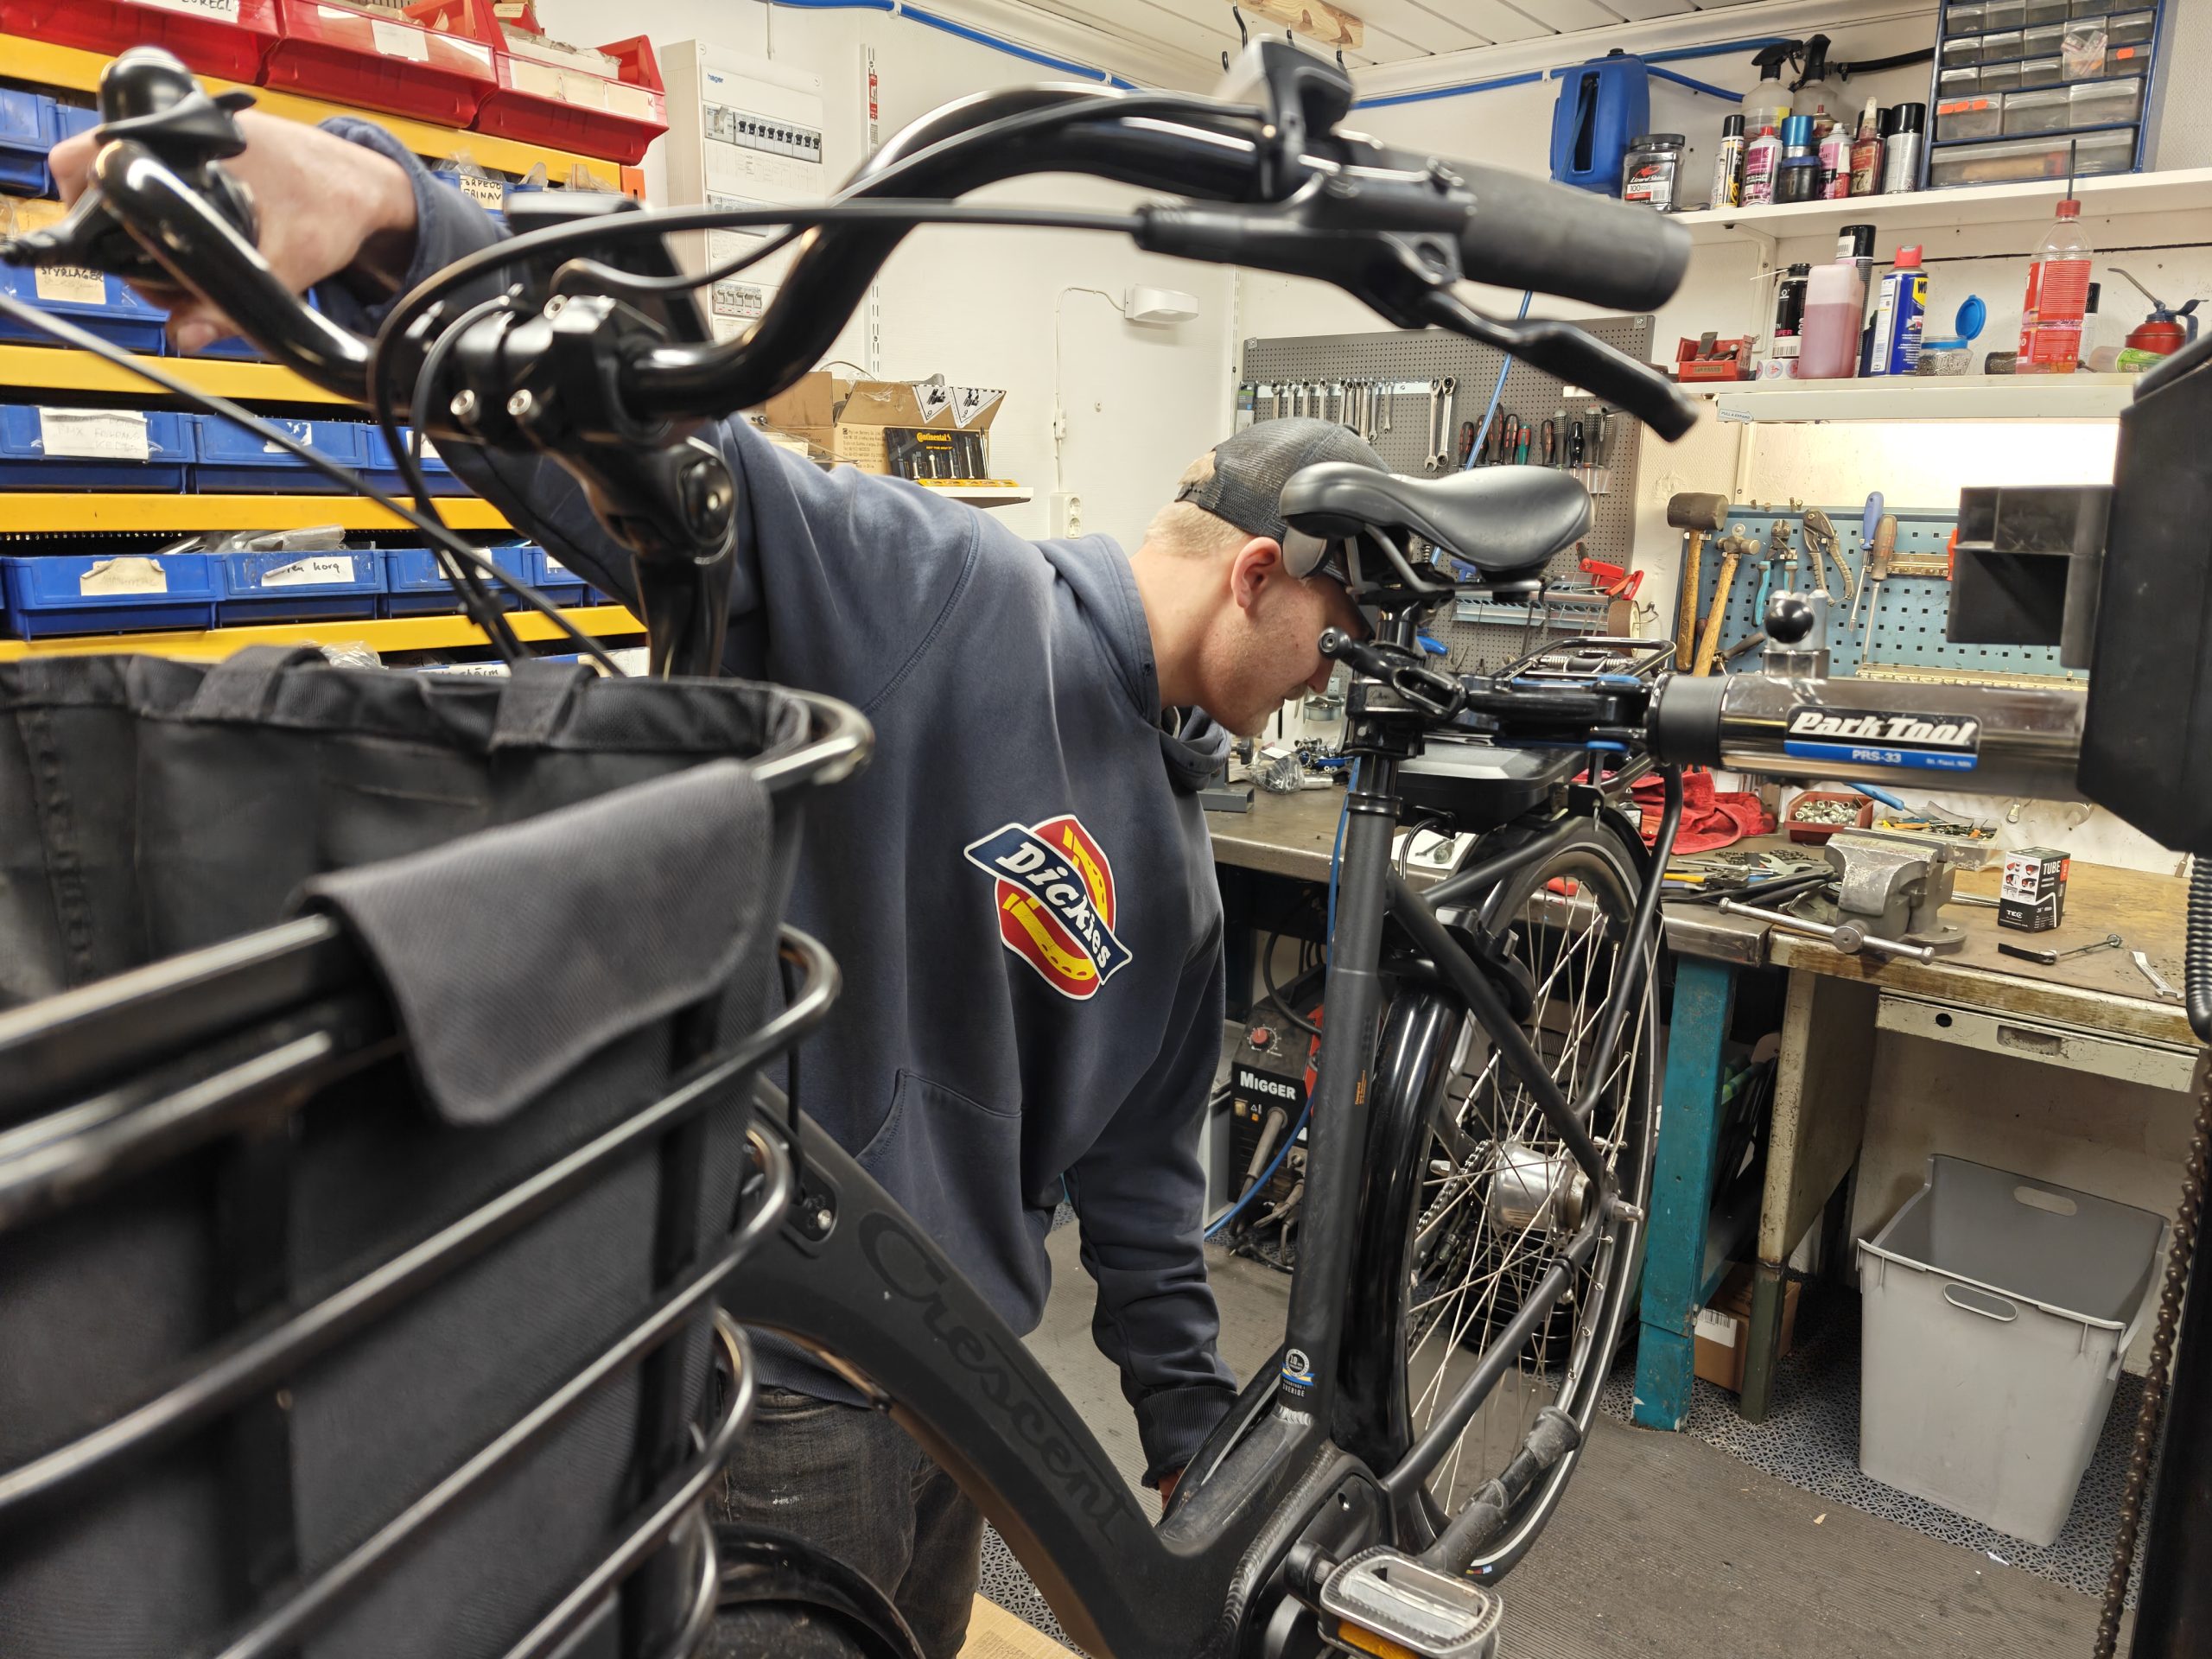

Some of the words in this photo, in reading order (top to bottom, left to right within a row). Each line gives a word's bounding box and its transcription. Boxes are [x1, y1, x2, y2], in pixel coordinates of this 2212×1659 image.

[707, 73, 724, 84] hager
[917, 432, 948, 442] Continental
[1852, 749, 1902, 764] PRS-33
[2043, 860, 2062, 875] TUBE
[995, 841, 1111, 969] Dickies
[2006, 909, 2024, 918] TEC
[858, 1211, 1136, 1549] Crescent
